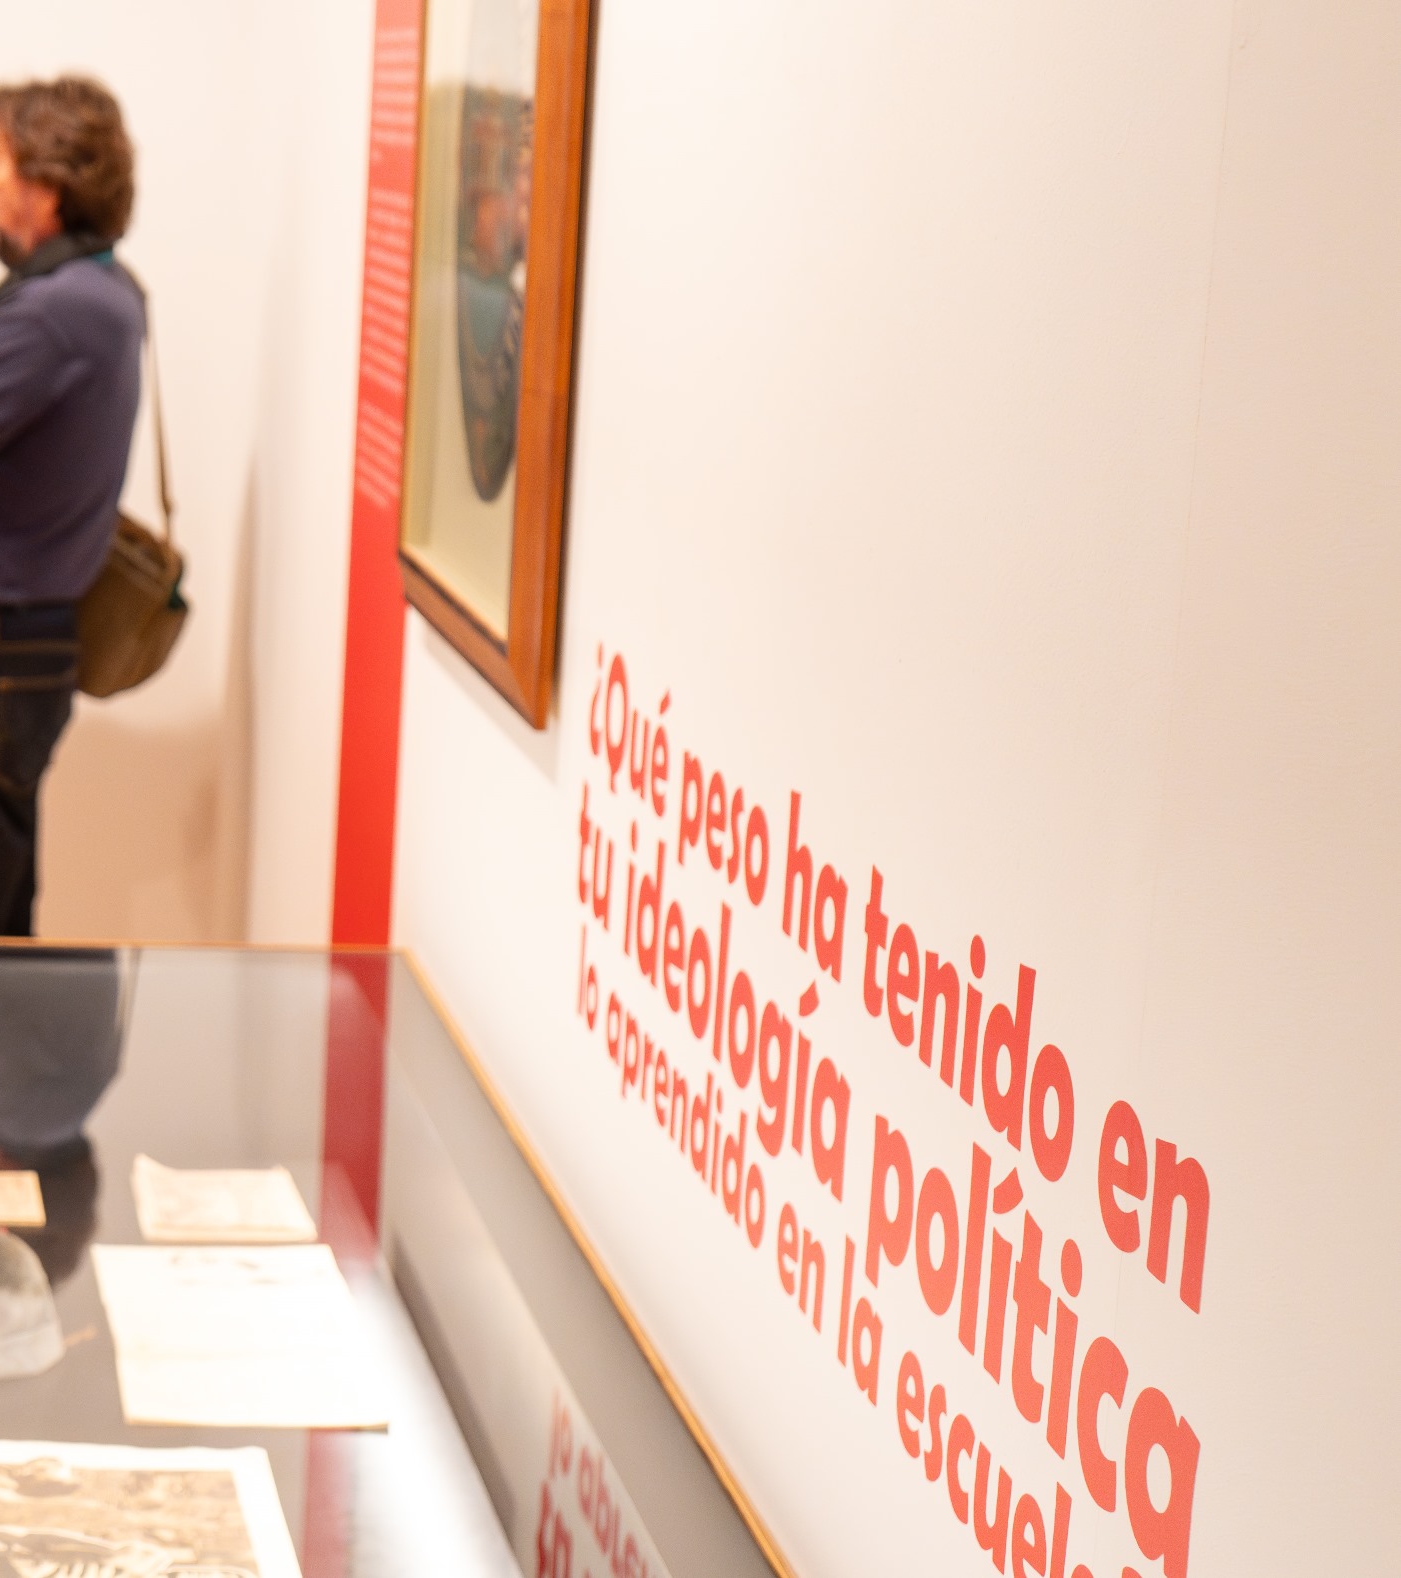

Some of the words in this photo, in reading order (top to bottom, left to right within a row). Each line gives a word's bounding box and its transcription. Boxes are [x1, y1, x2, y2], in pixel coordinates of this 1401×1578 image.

[577, 922, 598, 1031] lo
[606, 991, 766, 1249] aprendido
[777, 1202, 827, 1334] en
[837, 1233, 884, 1408] la
[896, 1350, 1143, 1578] escuel
[578, 780, 614, 932] tu
[623, 818, 852, 1203] ideología
[865, 1114, 1201, 1578] política
[589, 640, 671, 817] ¿Qué
[678, 751, 769, 907] peso
[782, 790, 848, 983] ha
[864, 865, 1075, 1183] tenido
[1098, 1100, 1210, 1314] en
